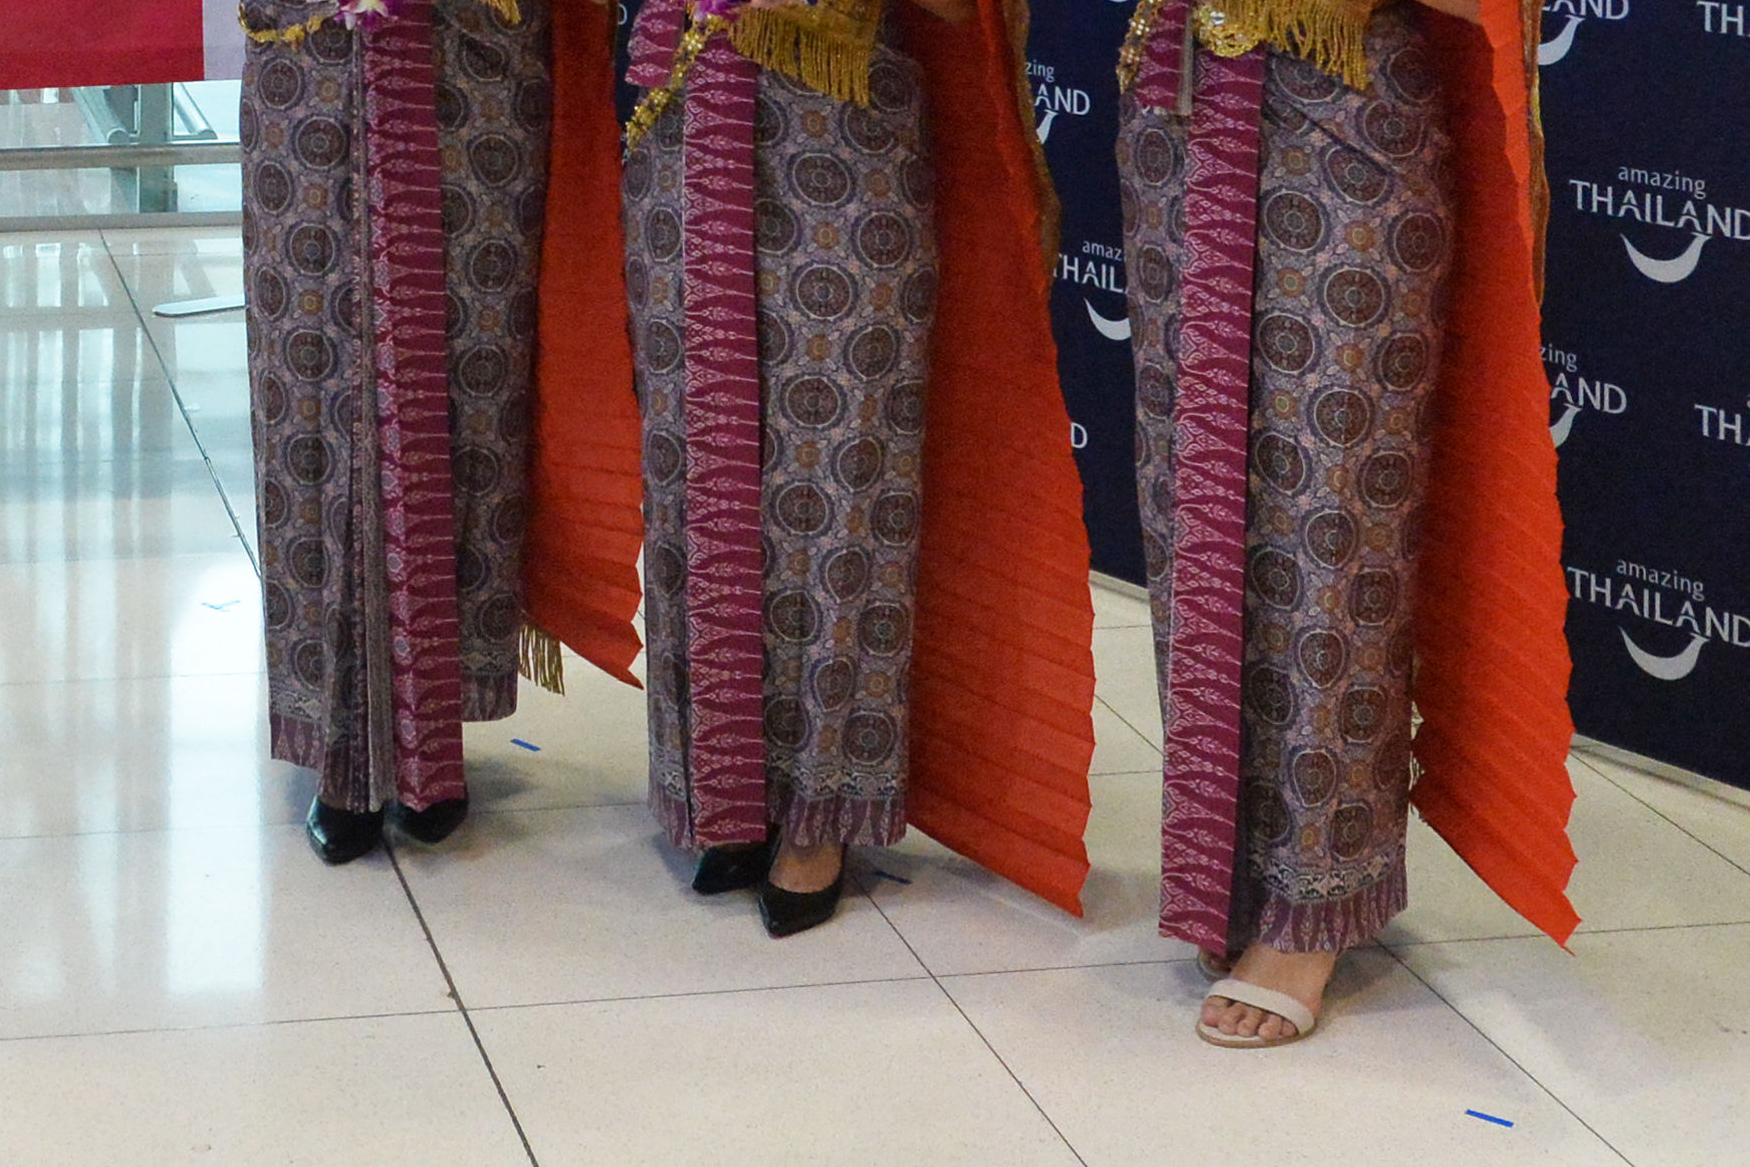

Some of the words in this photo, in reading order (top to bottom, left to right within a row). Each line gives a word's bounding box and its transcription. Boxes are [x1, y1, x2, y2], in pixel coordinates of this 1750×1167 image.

[1618, 165, 1707, 199] amazing
[1082, 240, 1123, 262] amaz
[1616, 559, 1705, 602] amazing
